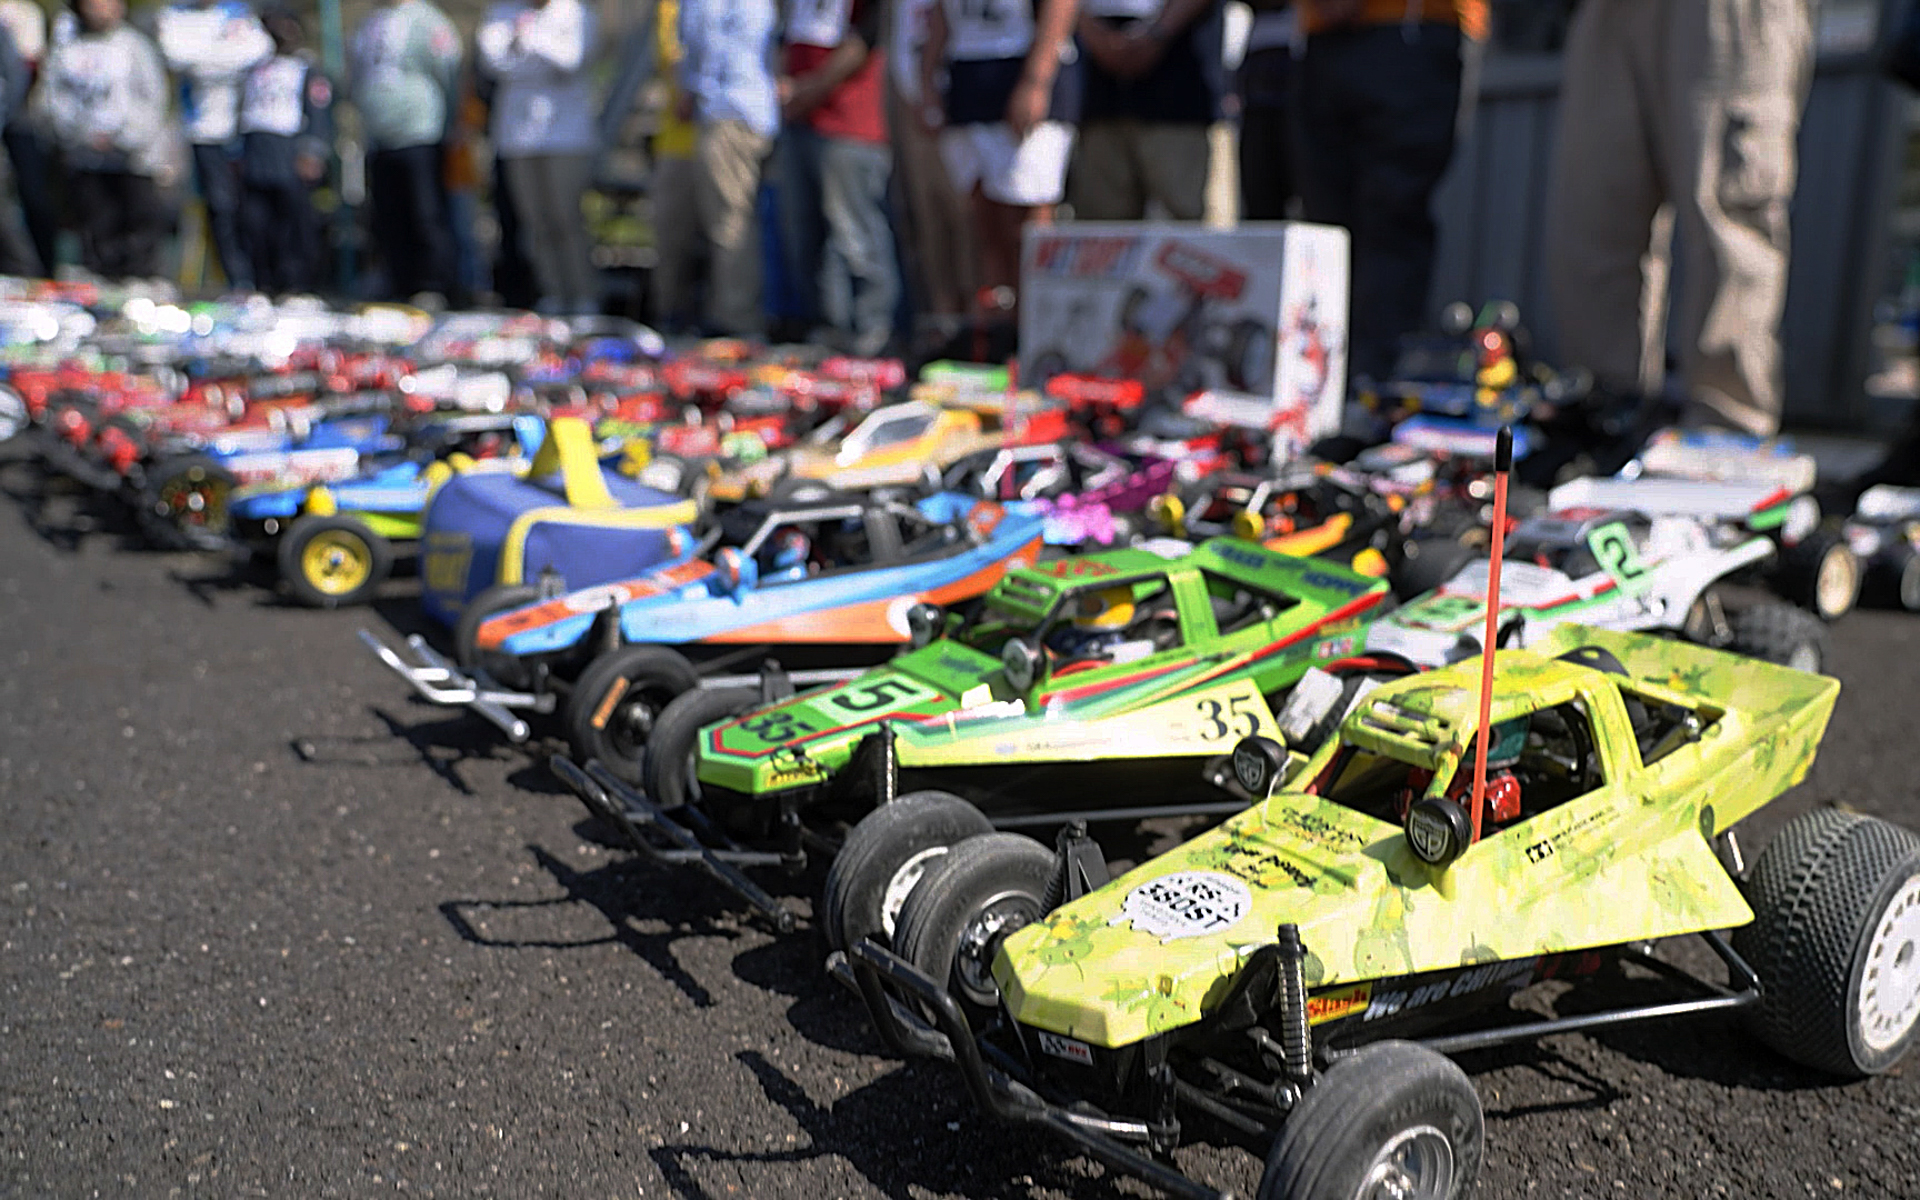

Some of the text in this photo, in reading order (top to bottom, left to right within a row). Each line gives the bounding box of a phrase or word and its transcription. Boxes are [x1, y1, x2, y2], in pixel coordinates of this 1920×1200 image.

[1603, 536, 1643, 578] 2
[831, 680, 922, 711] 5
[1197, 694, 1260, 741] 35
[1363, 990, 1408, 1022] We
